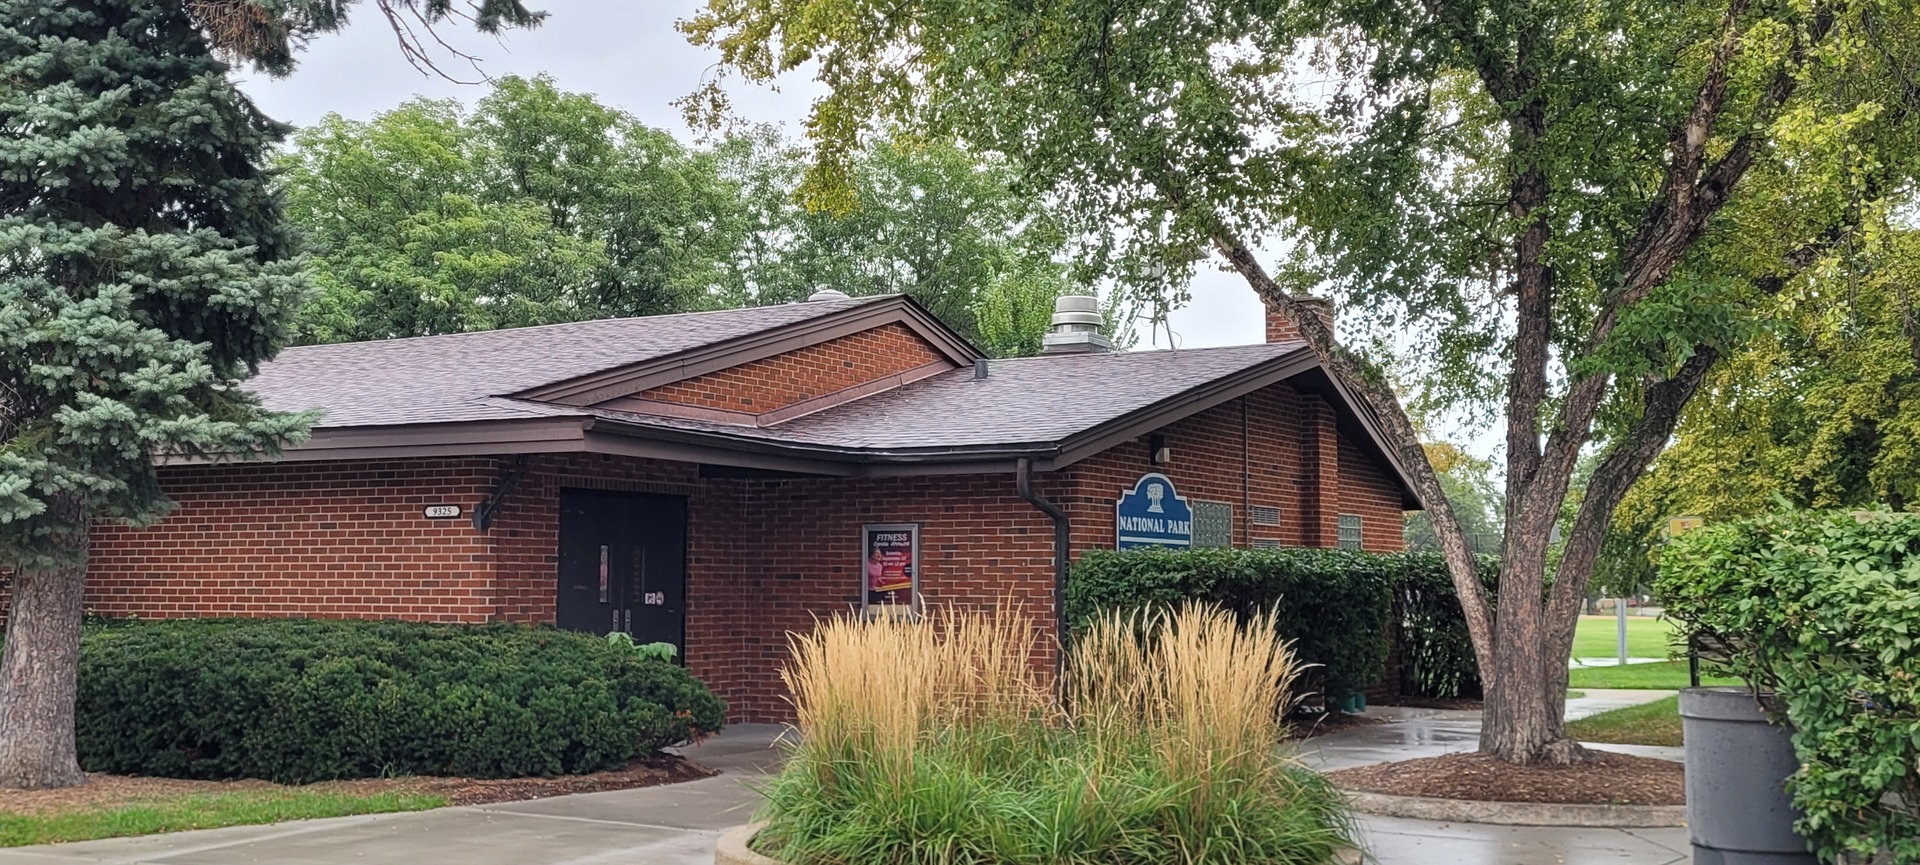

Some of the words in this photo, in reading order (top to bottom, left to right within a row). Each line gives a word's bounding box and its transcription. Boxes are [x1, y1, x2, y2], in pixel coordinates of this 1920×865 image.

[432, 507, 452, 515] 9325
[1119, 516, 1165, 533] NATIONAL
[1167, 520, 1190, 535] PARK
[876, 533, 908, 541] FITNESS
